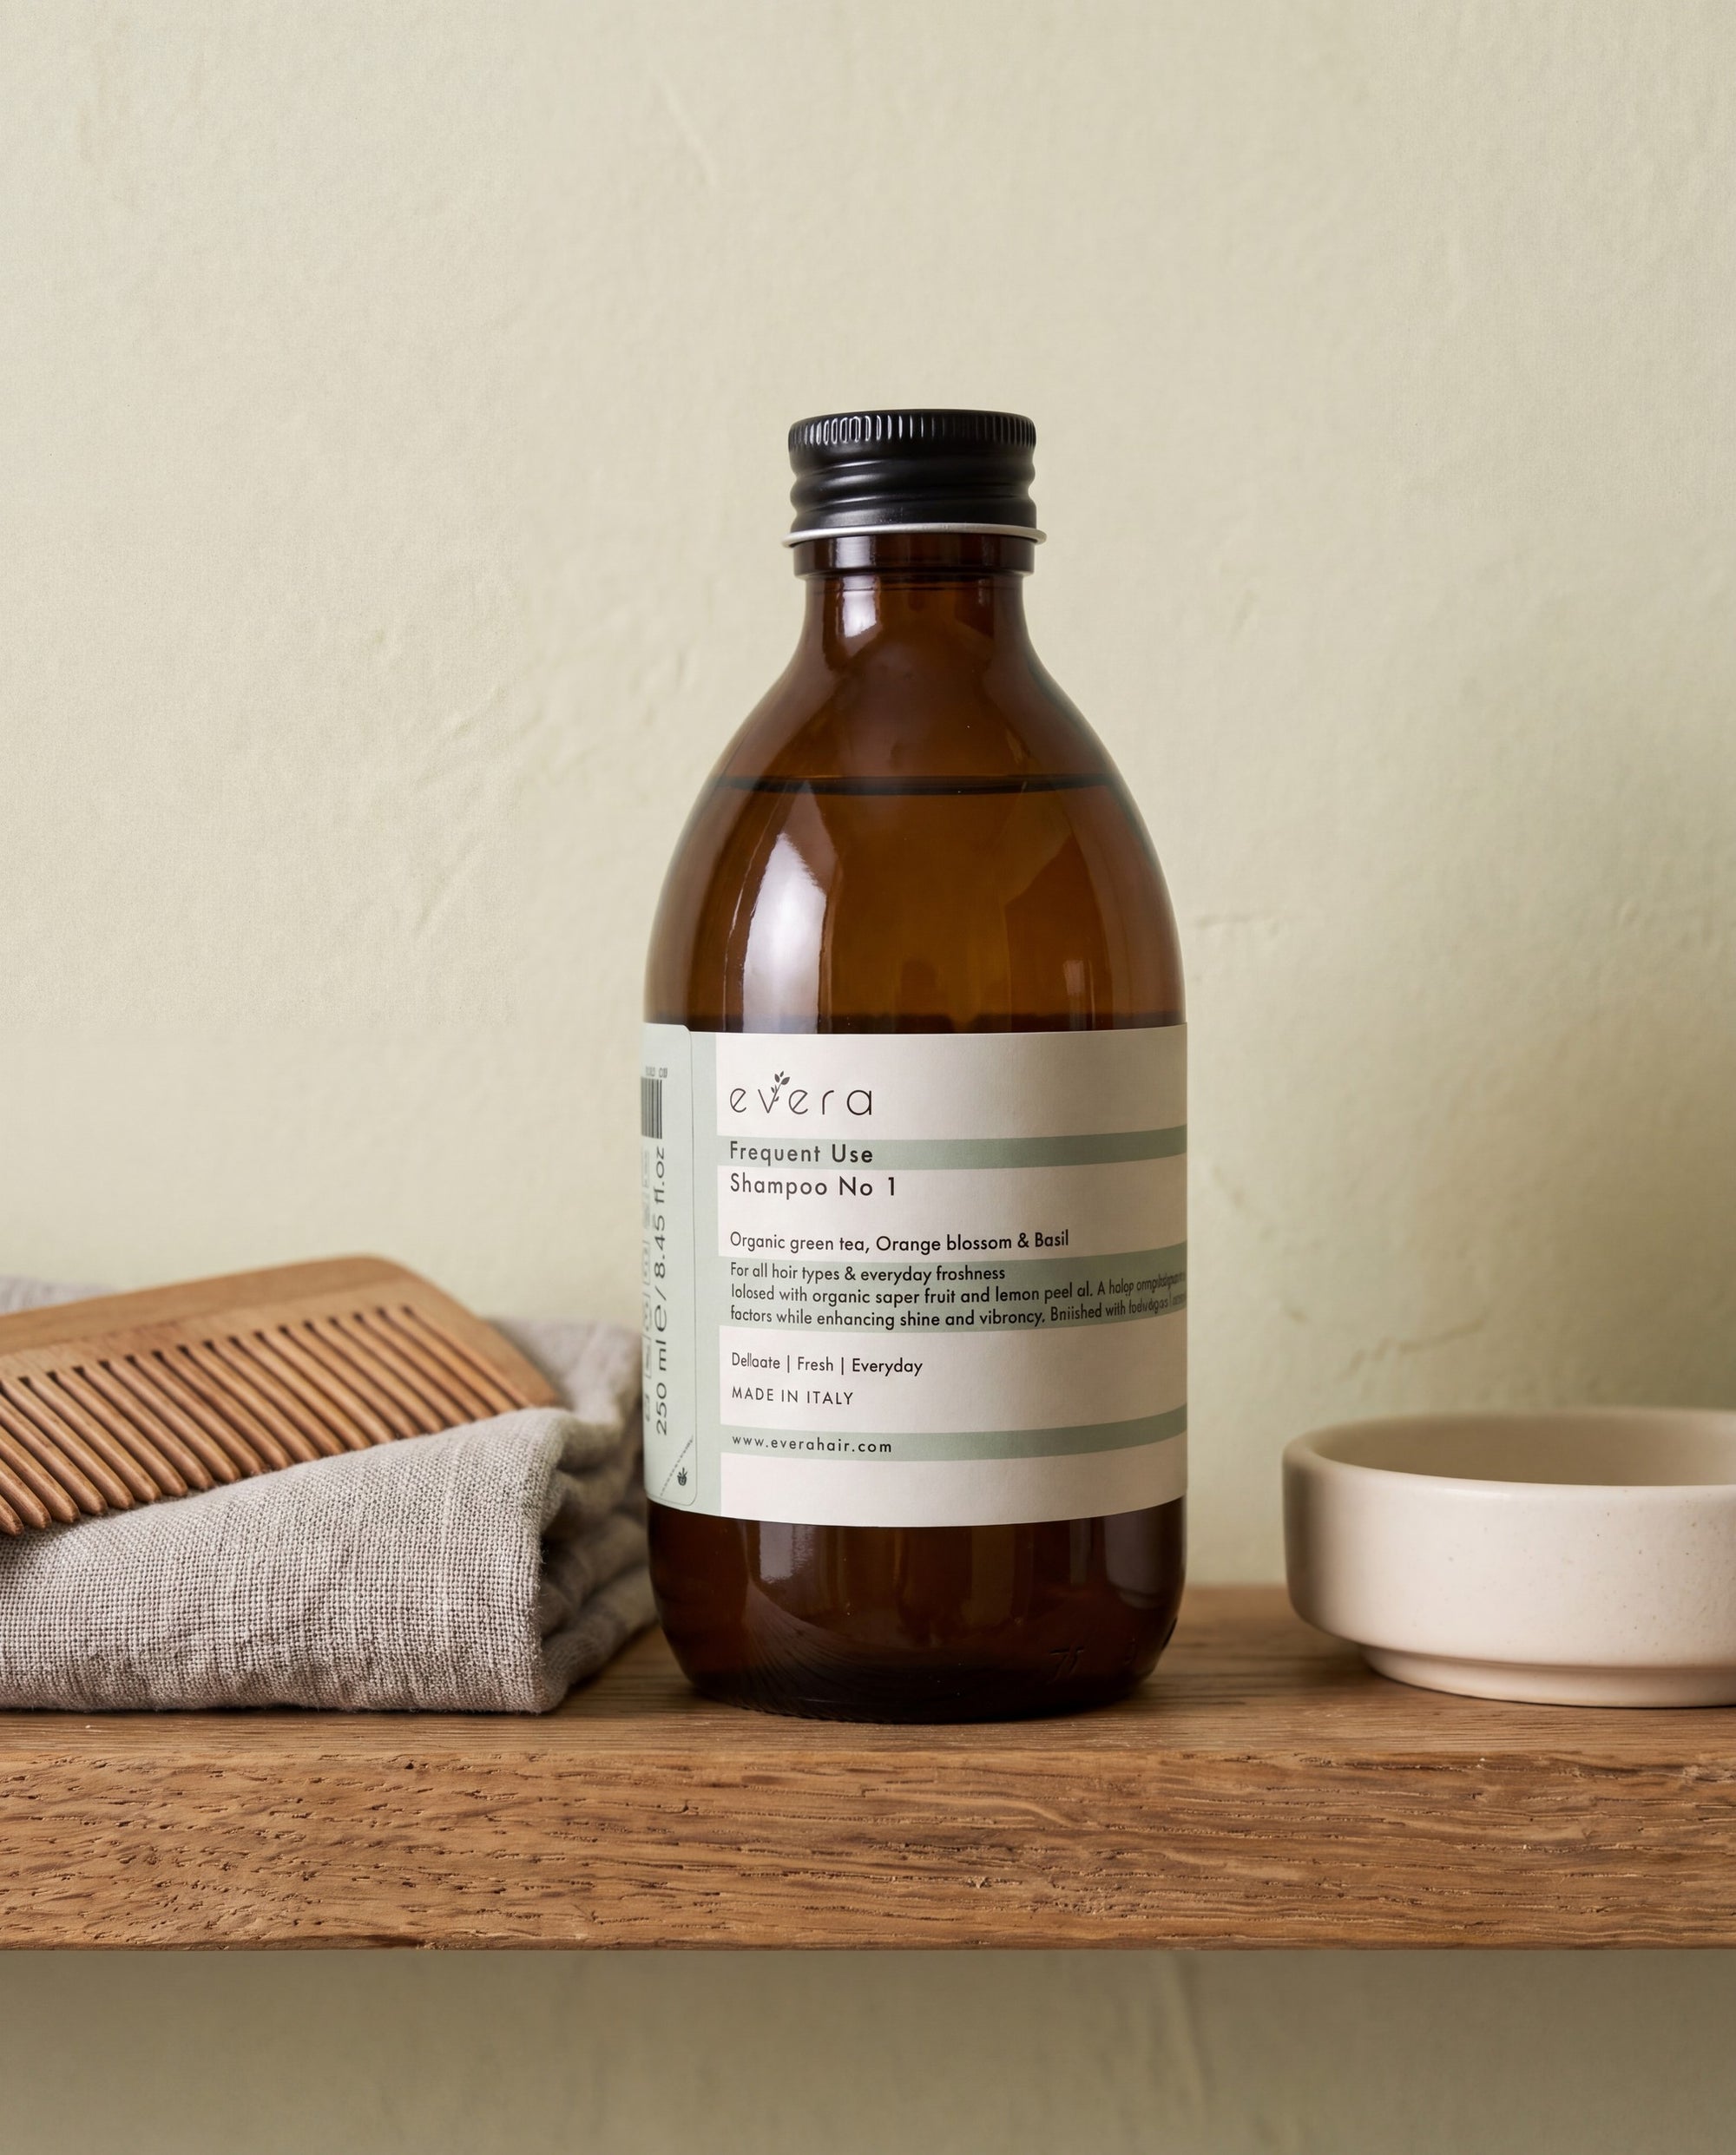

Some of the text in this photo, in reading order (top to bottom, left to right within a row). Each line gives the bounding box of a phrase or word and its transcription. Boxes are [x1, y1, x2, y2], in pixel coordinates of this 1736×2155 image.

[730, 1087, 872, 1116] evera
[731, 1140, 873, 1167] Frequent Use
[730, 1172, 895, 1201] Shampoo No 1
[654, 1214, 666, 1279] 8.45
[730, 1228, 1069, 1256] Organic green tea, Orange blossom & Basil
[730, 1261, 750, 1277] For
[752, 1262, 768, 1278] all
[801, 1266, 840, 1284] types
[844, 1265, 857, 1281] &
[860, 1265, 932, 1286] everyday
[936, 1264, 1006, 1281] froshness
[779, 1285, 808, 1302] with
[812, 1288, 871, 1308] organic
[875, 1293, 921, 1309] saper
[924, 1287, 957, 1304] fruit
[960, 1285, 990, 1304] and
[995, 1284, 1040, 1303] lemon
[1043, 1281, 1073, 1305] peel
[1096, 1280, 1107, 1297] A
[776, 1307, 812, 1325] while
[816, 1309, 895, 1331] enhancing
[899, 1310, 941, 1327] shine
[944, 1308, 975, 1327] and
[1105, 1299, 1127, 1317] with
[655, 1340, 667, 1372] ml
[797, 1356, 834, 1372] Fresh
[852, 1357, 924, 1377] Everyday
[655, 1383, 667, 1436] 250
[732, 1385, 854, 1405] MADE IN ITALY
[732, 1436, 892, 1454] www.everahair.com
